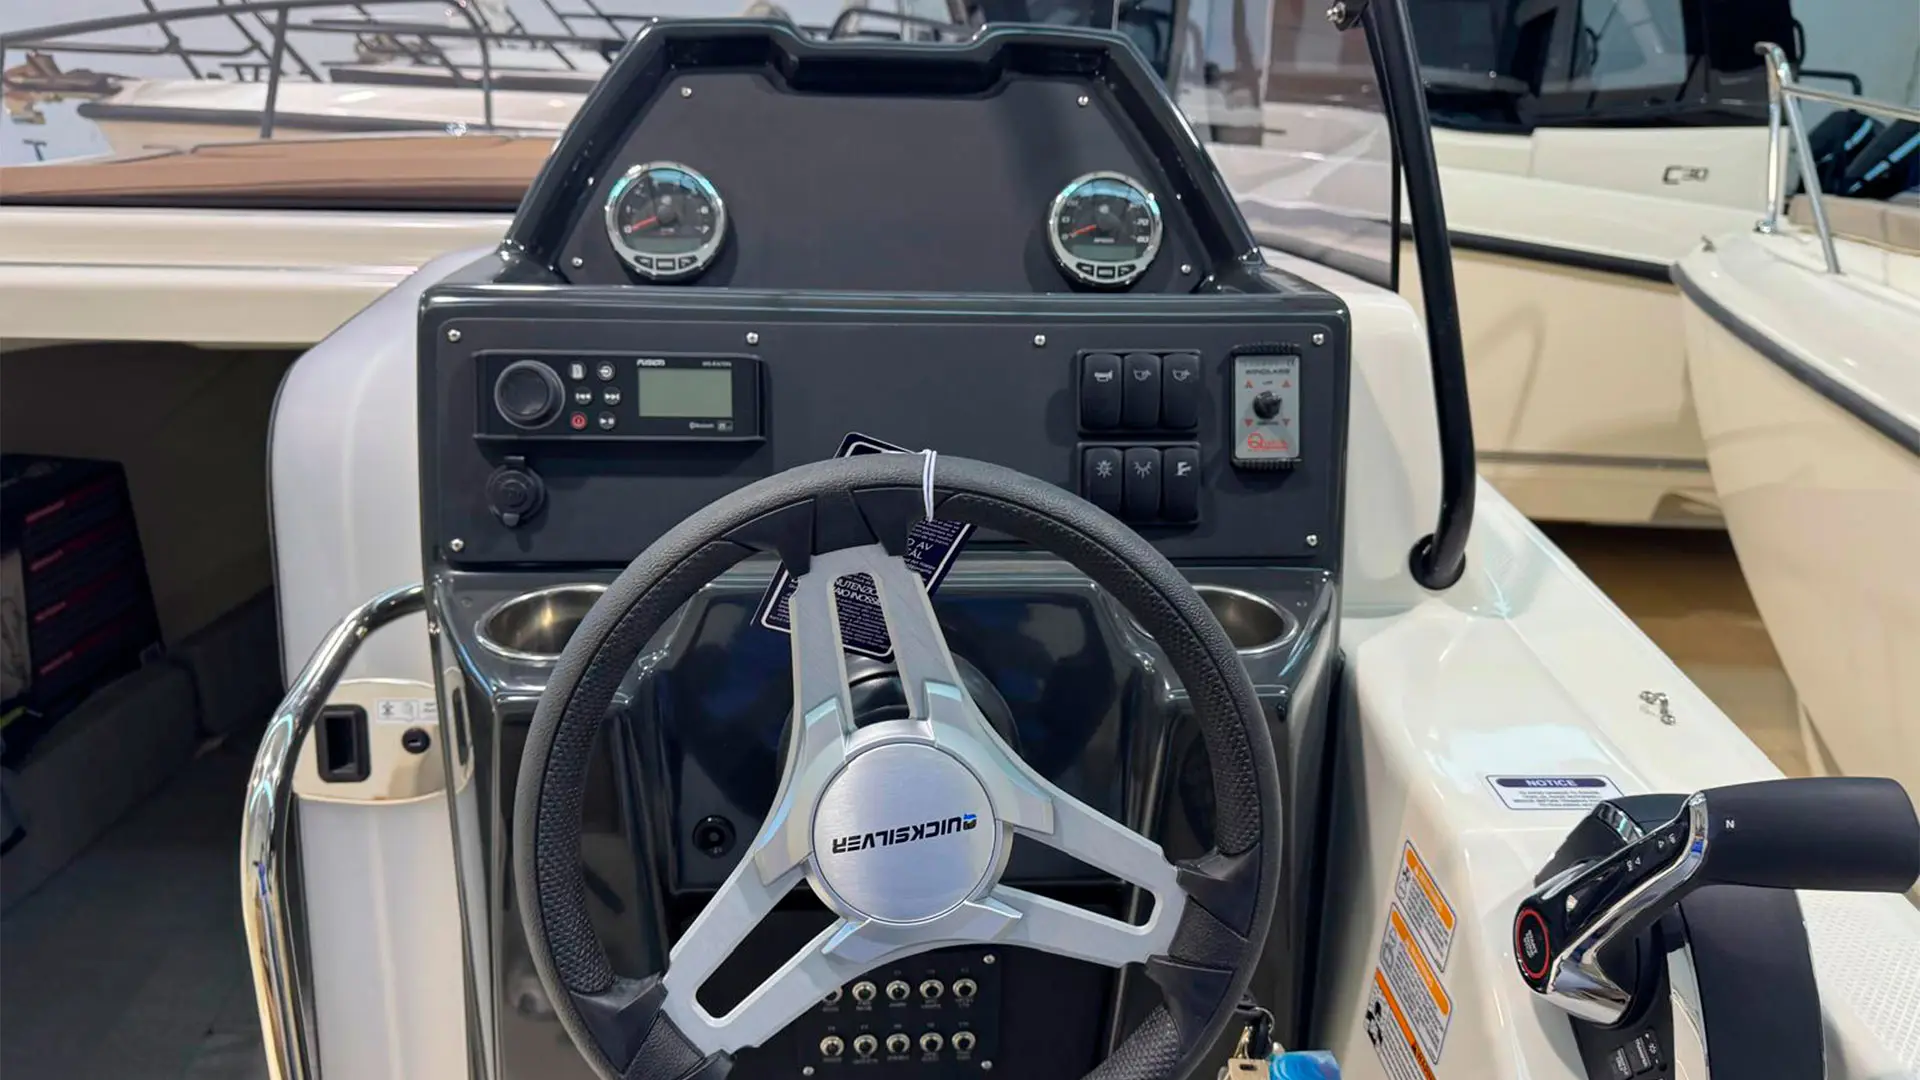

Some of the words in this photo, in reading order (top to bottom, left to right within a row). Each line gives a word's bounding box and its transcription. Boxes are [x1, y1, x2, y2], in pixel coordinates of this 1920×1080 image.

[1661, 165, 1709, 185] C30
[1525, 778, 1578, 788] NOTICE
[1725, 819, 1736, 829] N
[832, 813, 977, 854] QUICKSILVER
